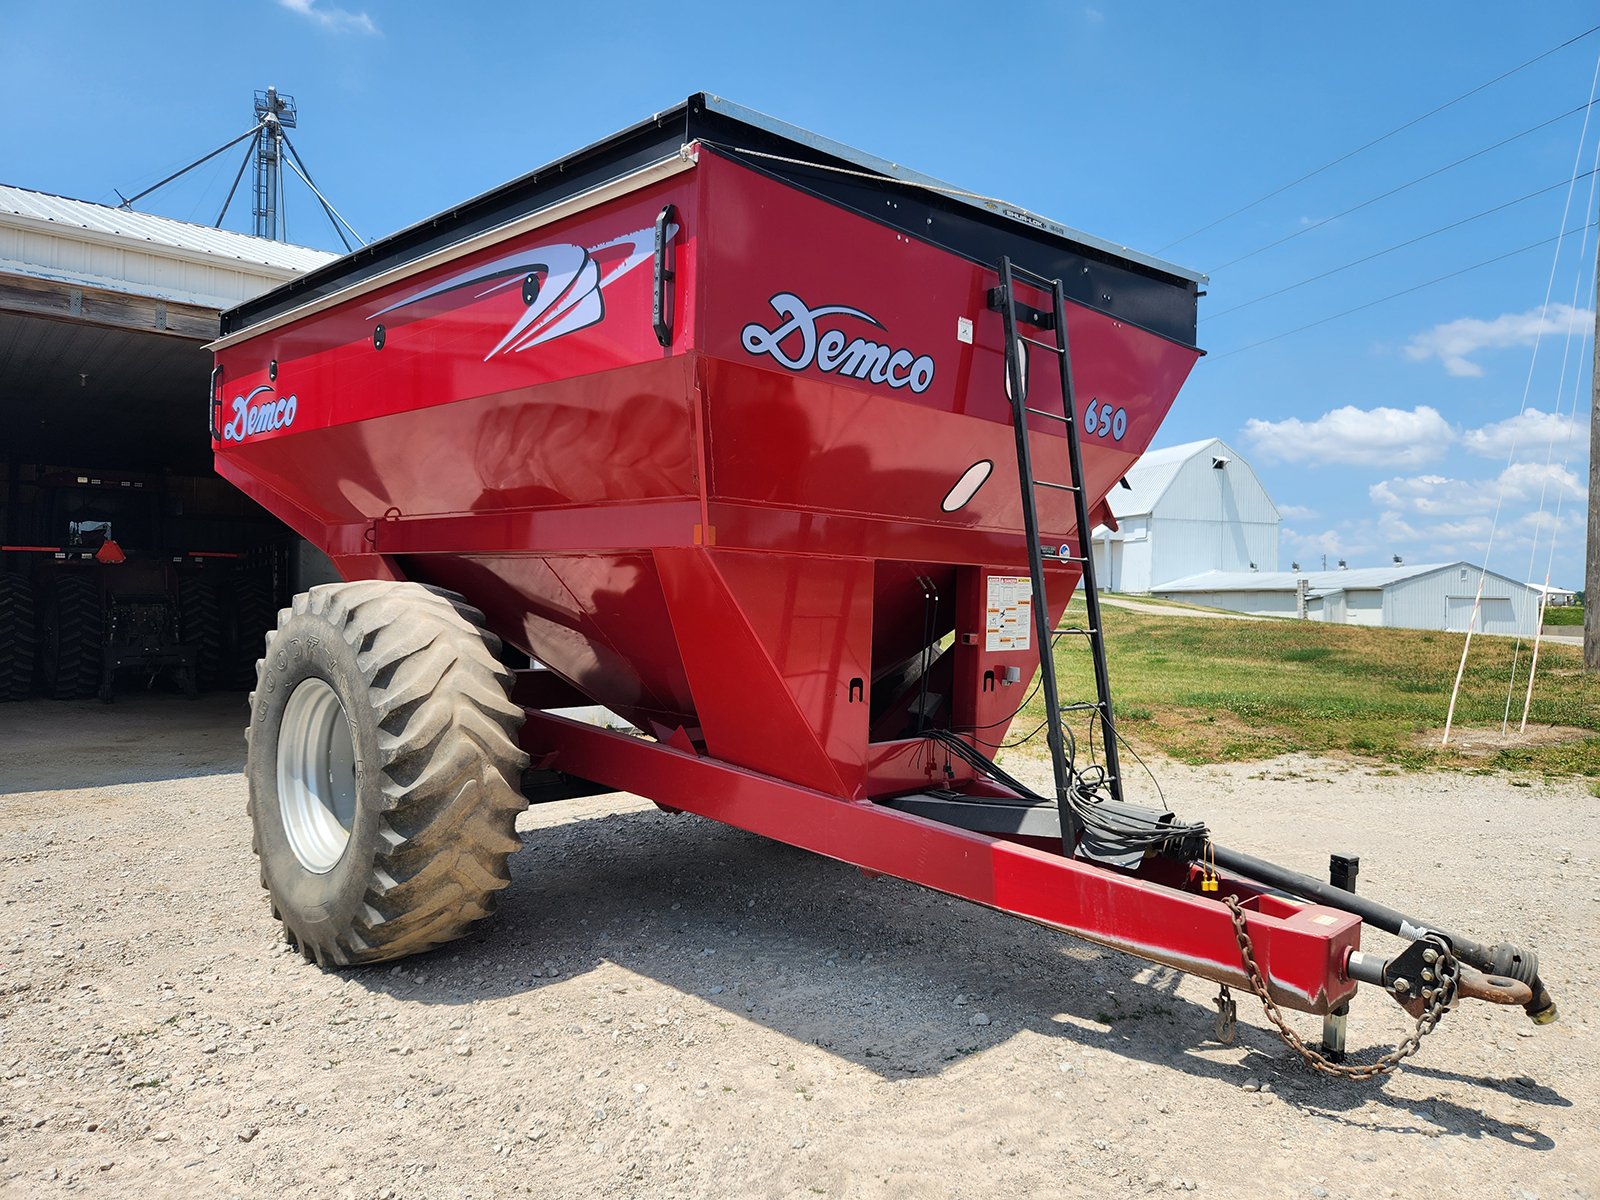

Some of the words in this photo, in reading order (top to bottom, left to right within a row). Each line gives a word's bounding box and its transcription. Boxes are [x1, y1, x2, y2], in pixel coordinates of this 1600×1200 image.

[739, 291, 935, 394] Demco
[224, 384, 297, 442] Demco
[1084, 397, 1127, 442] 650
